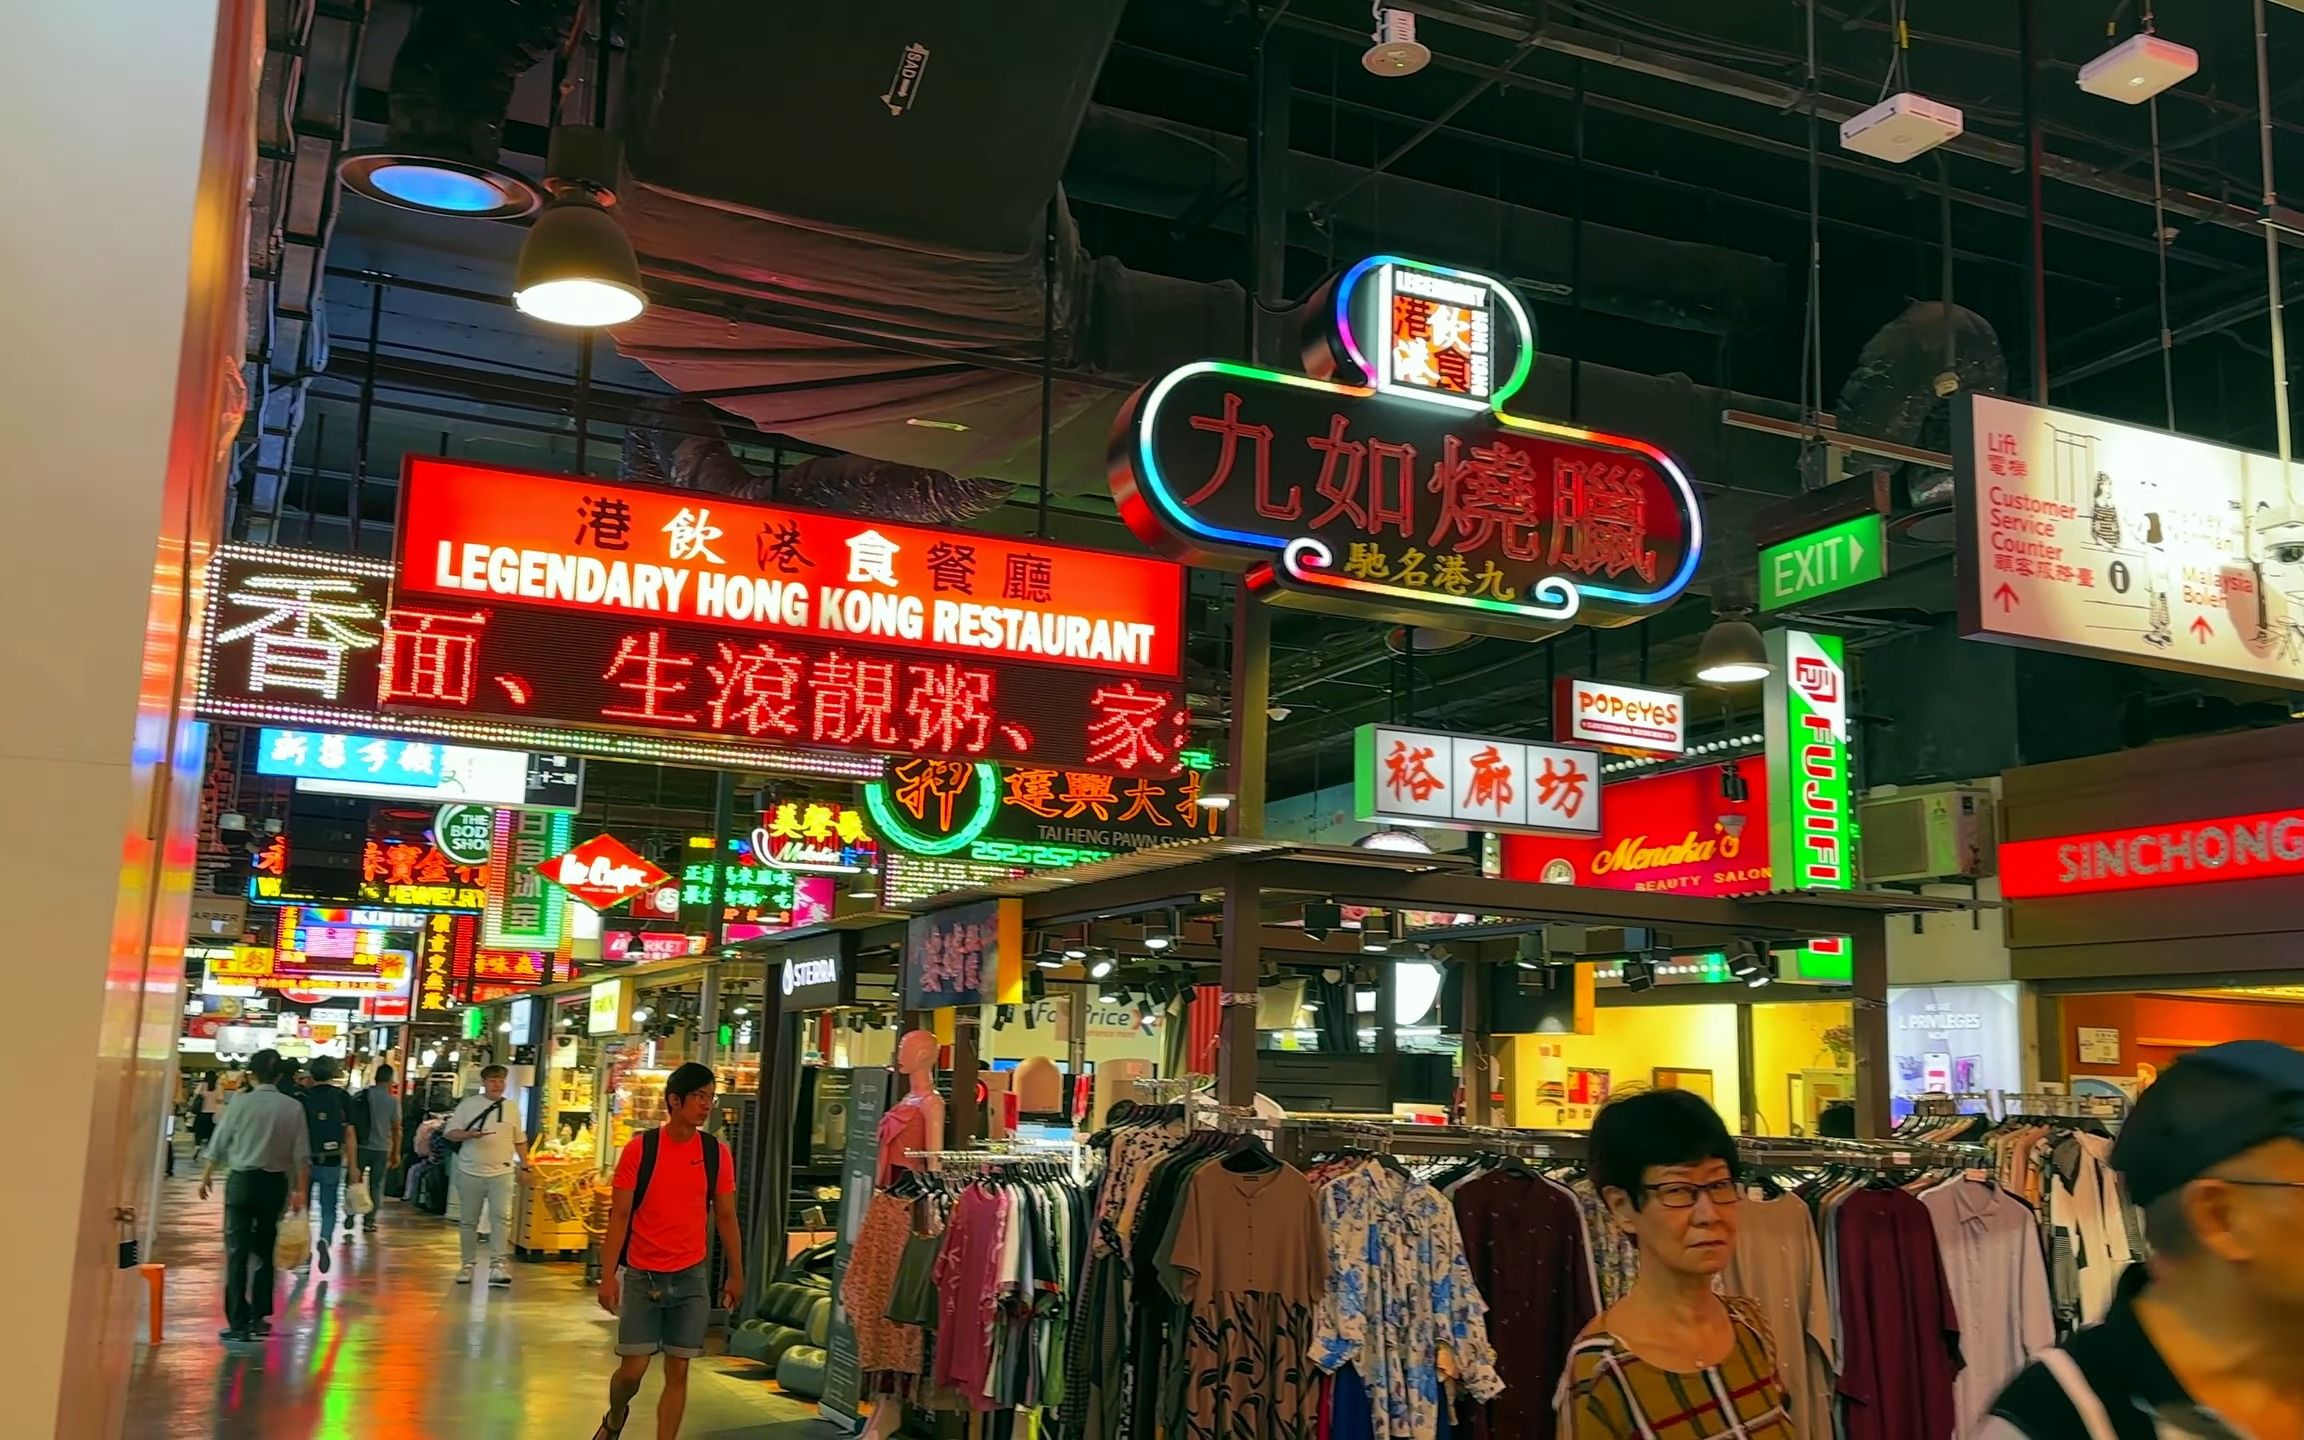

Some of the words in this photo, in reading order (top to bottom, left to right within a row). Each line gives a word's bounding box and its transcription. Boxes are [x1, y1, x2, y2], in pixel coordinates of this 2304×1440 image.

[1988, 432, 2018, 455] Lift
[1989, 486, 2077, 520] Customer
[1990, 508, 2056, 538] Service
[1991, 531, 2063, 561] Counter
[1774, 536, 1844, 597] EXIT
[437, 540, 689, 613] LEGENDARY
[697, 570, 808, 627] HONG
[819, 586, 923, 642] KONG
[933, 600, 1155, 666] RESTAURANT
[215, 574, 380, 700] 香
[1386, 740, 1589, 819] 裕廊坊
[450, 826, 490, 838] BOD
[460, 813, 490, 826] THE
[1801, 713, 1843, 954] FUJIFI
[451, 838, 490, 851] SHO
[1037, 824, 1062, 841] TAI
[1065, 827, 1110, 846] HENG
[1113, 830, 1158, 848] PAWN
[2058, 816, 2304, 884] SINCHONG
